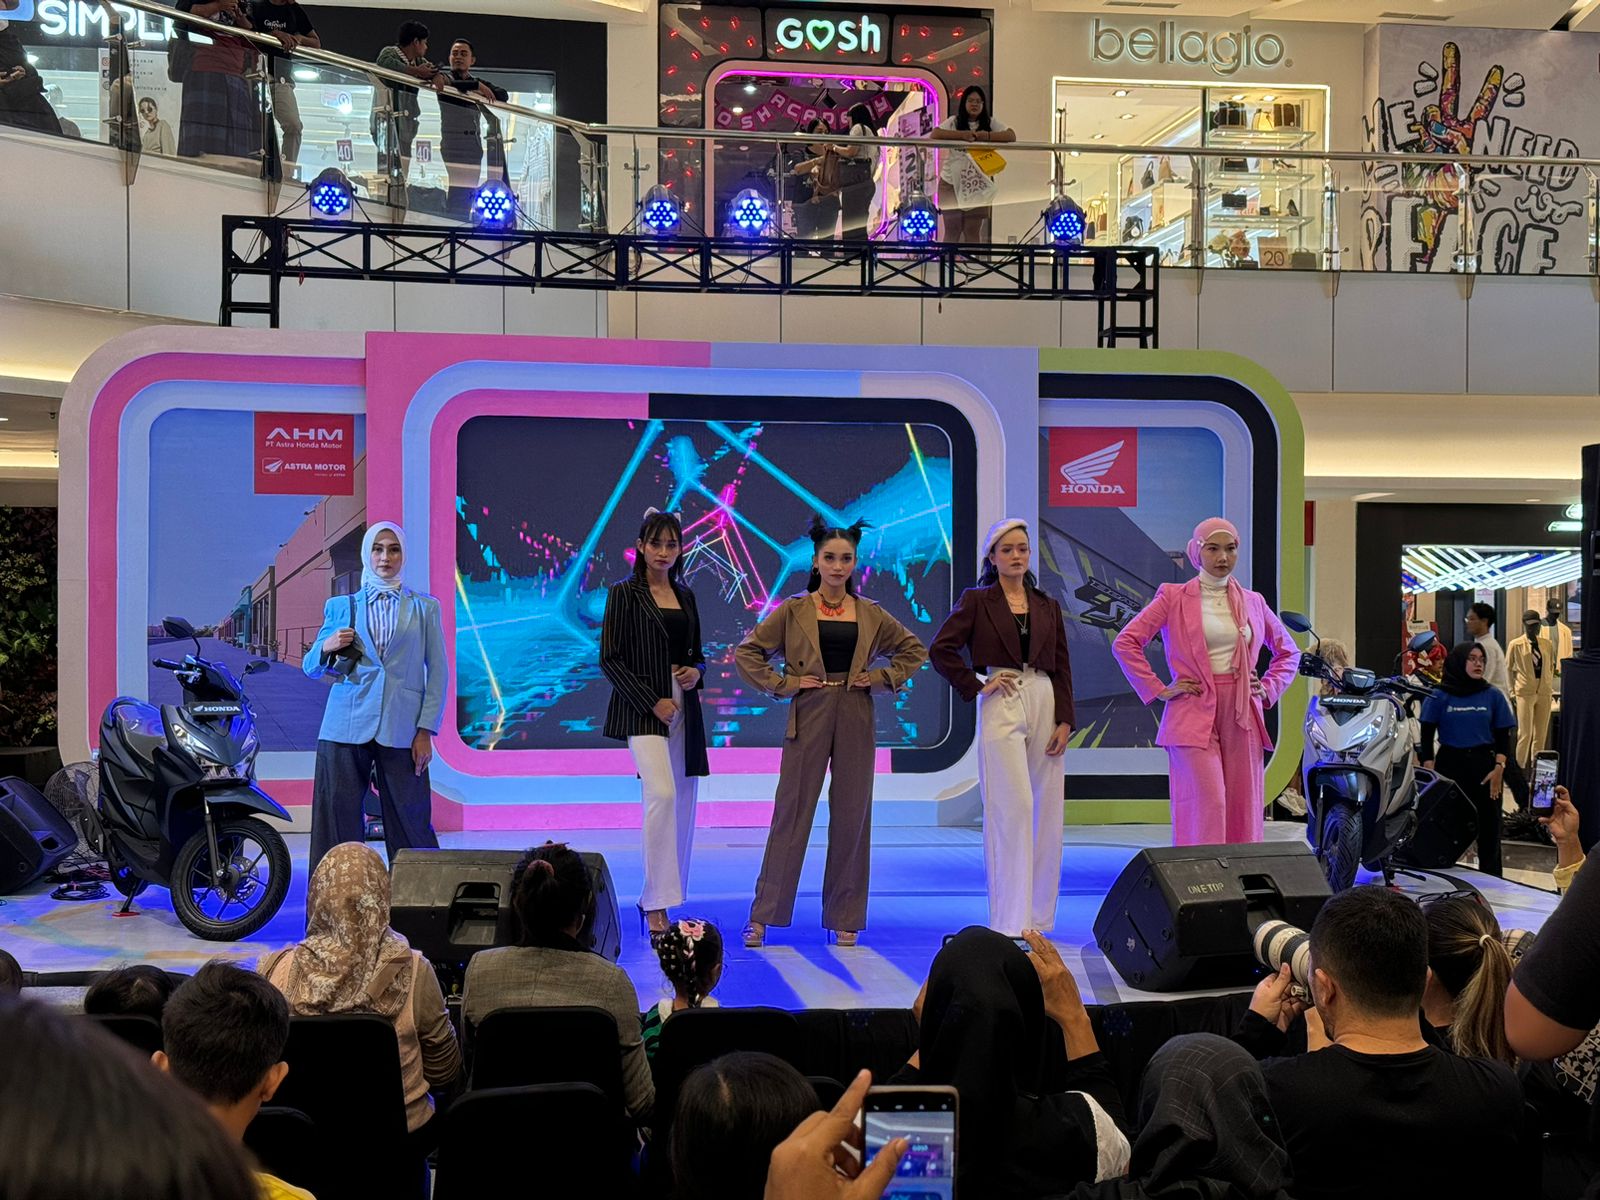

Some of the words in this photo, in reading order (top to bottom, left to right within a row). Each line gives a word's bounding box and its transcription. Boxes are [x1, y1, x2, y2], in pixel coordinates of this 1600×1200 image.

[1091, 18, 1285, 76] bellagio
[339, 145, 351, 160] 40
[1470, 115, 1580, 191] NEED
[266, 427, 343, 441] AHM
[284, 463, 313, 471] ASTRA
[1060, 484, 1126, 494] HONDA
